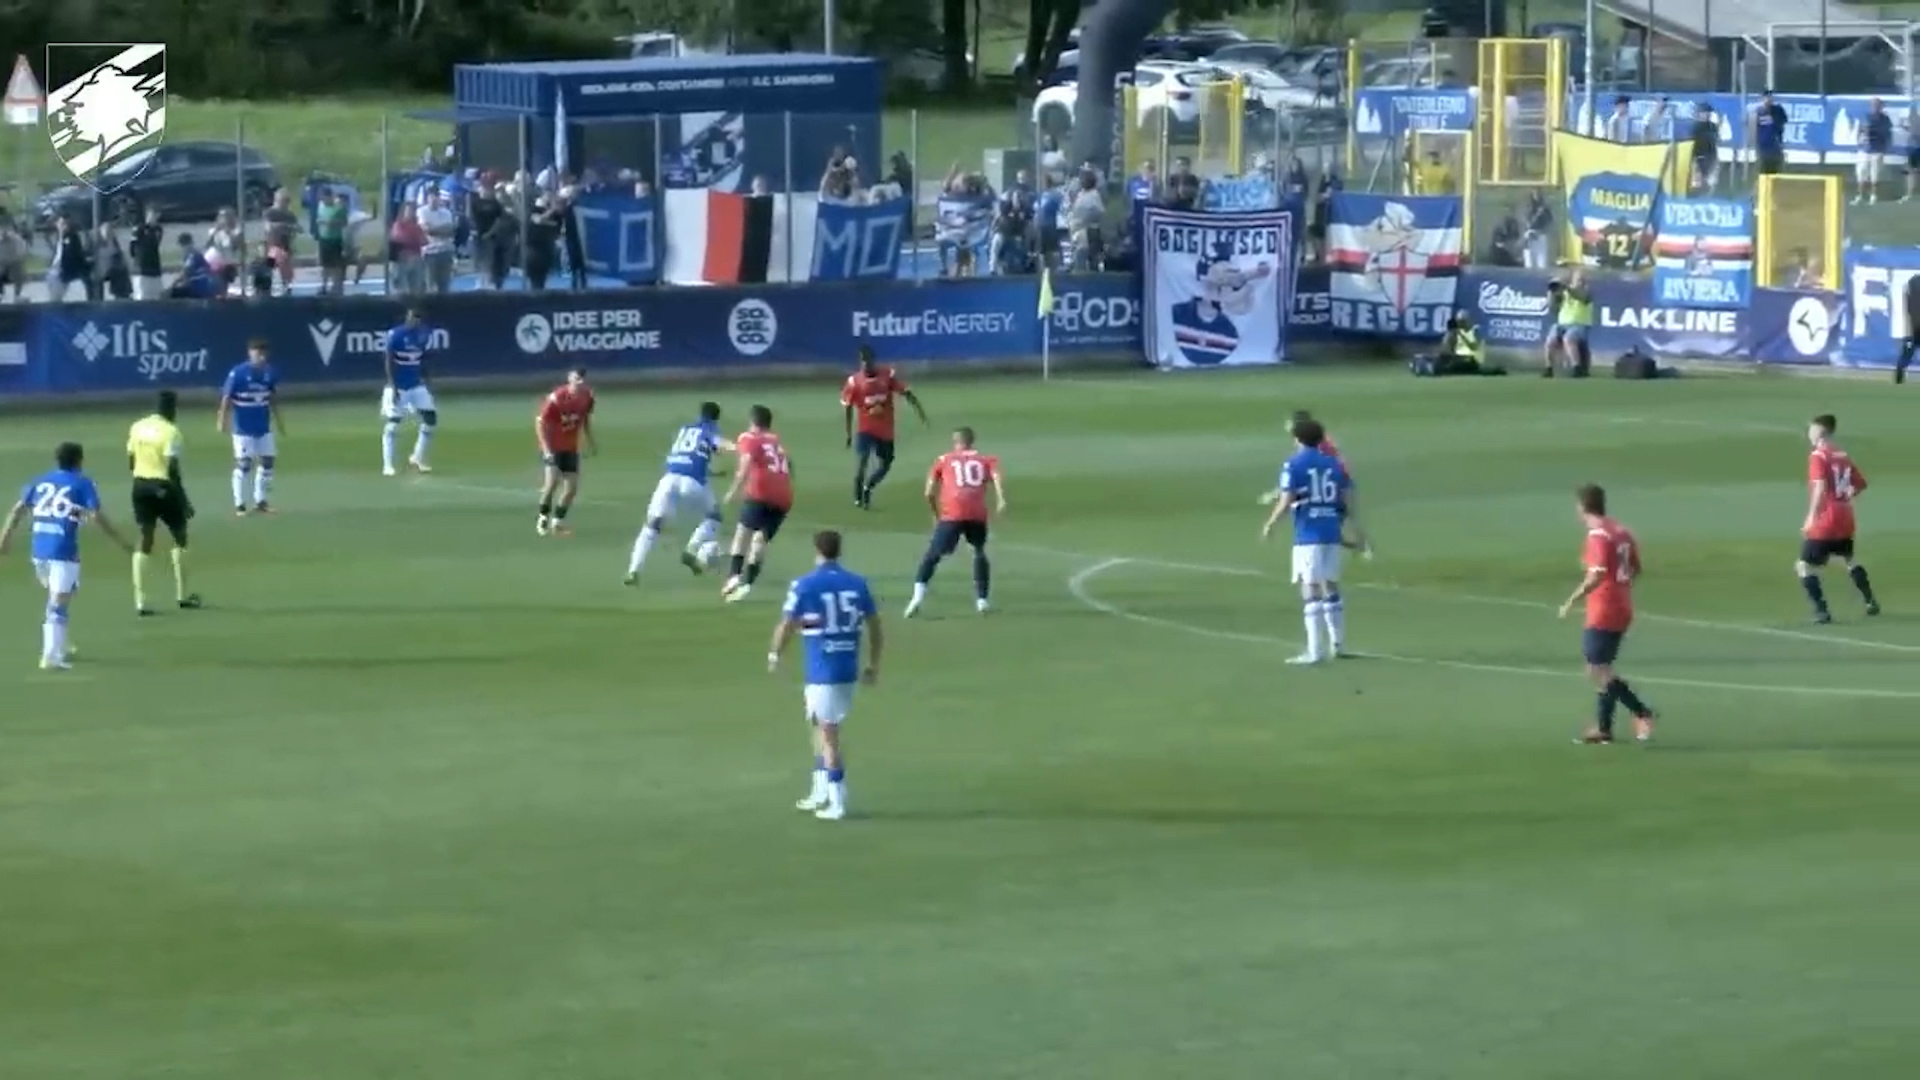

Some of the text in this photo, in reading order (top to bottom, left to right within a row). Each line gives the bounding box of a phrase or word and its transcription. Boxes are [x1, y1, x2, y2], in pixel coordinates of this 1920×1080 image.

[1590, 188, 1650, 211] MAGLIA
[1606, 233, 1629, 257] 12
[553, 308, 642, 331] IDEE PER
[1331, 300, 1452, 333] RECCO
[1601, 306, 1737, 333] LAKLINE
[346, 328, 450, 353] man
[553, 330, 661, 352] VIAGGIARE
[137, 348, 207, 380] sport
[951, 460, 985, 487] 10
[1307, 467, 1337, 503] 16
[33, 482, 72, 518] 26
[820, 591, 863, 634] 15
